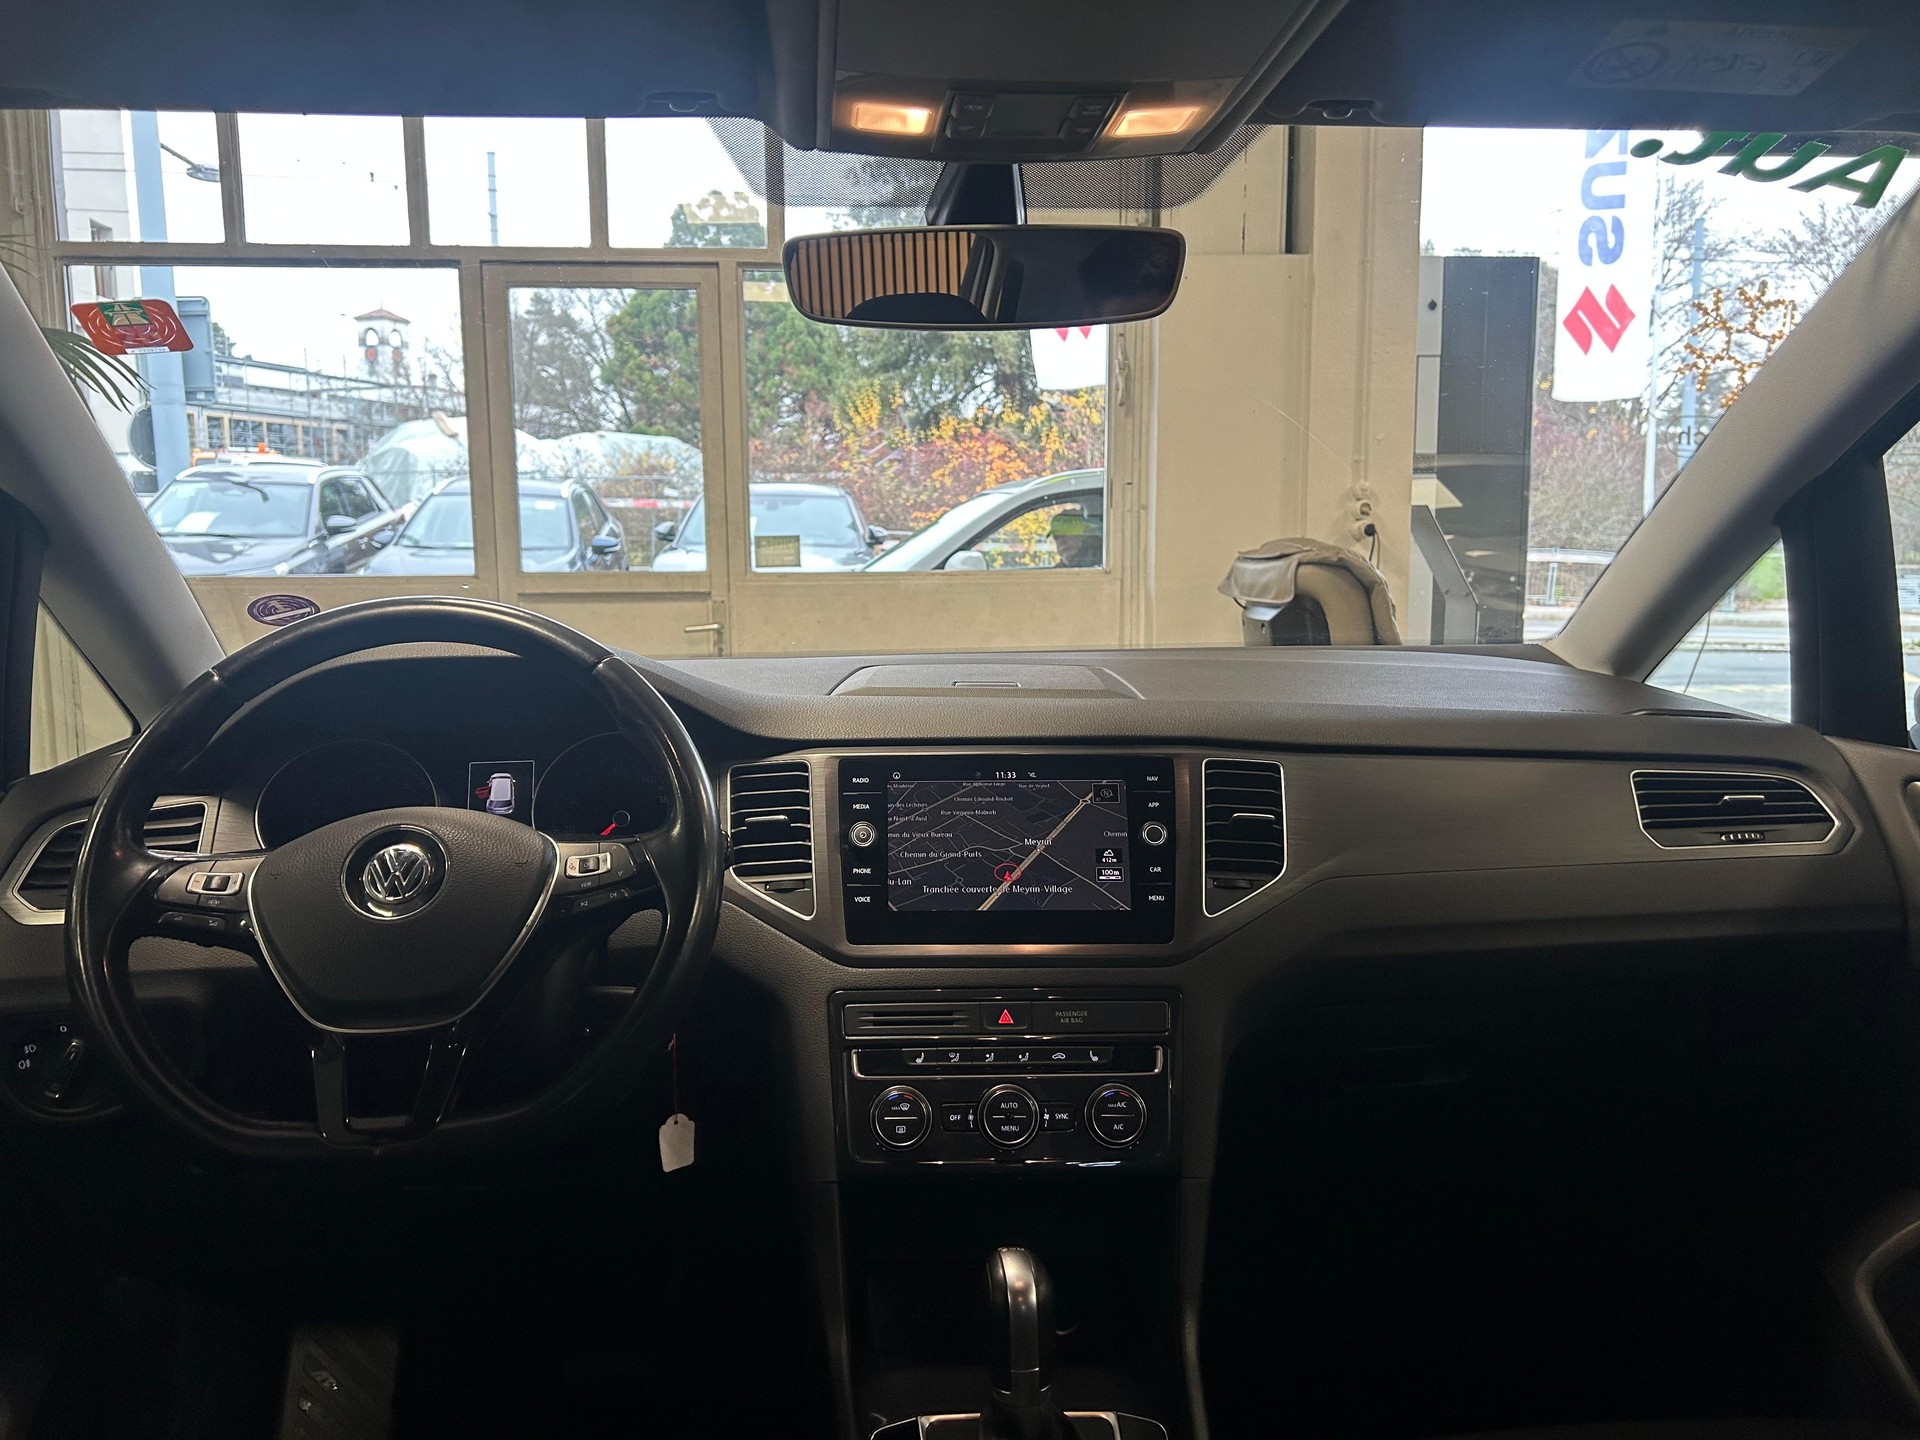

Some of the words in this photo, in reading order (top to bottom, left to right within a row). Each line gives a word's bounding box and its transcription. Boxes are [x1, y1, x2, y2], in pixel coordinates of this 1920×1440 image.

[995, 771, 1017, 779] 11:33
[1024, 838, 1052, 846] Meyrin
[961, 885, 997, 893] couverte
[1012, 884, 1073, 895] Meyrin-Village
[949, 1110, 961, 1121] OFF
[1054, 1112, 1069, 1120] SYNC
